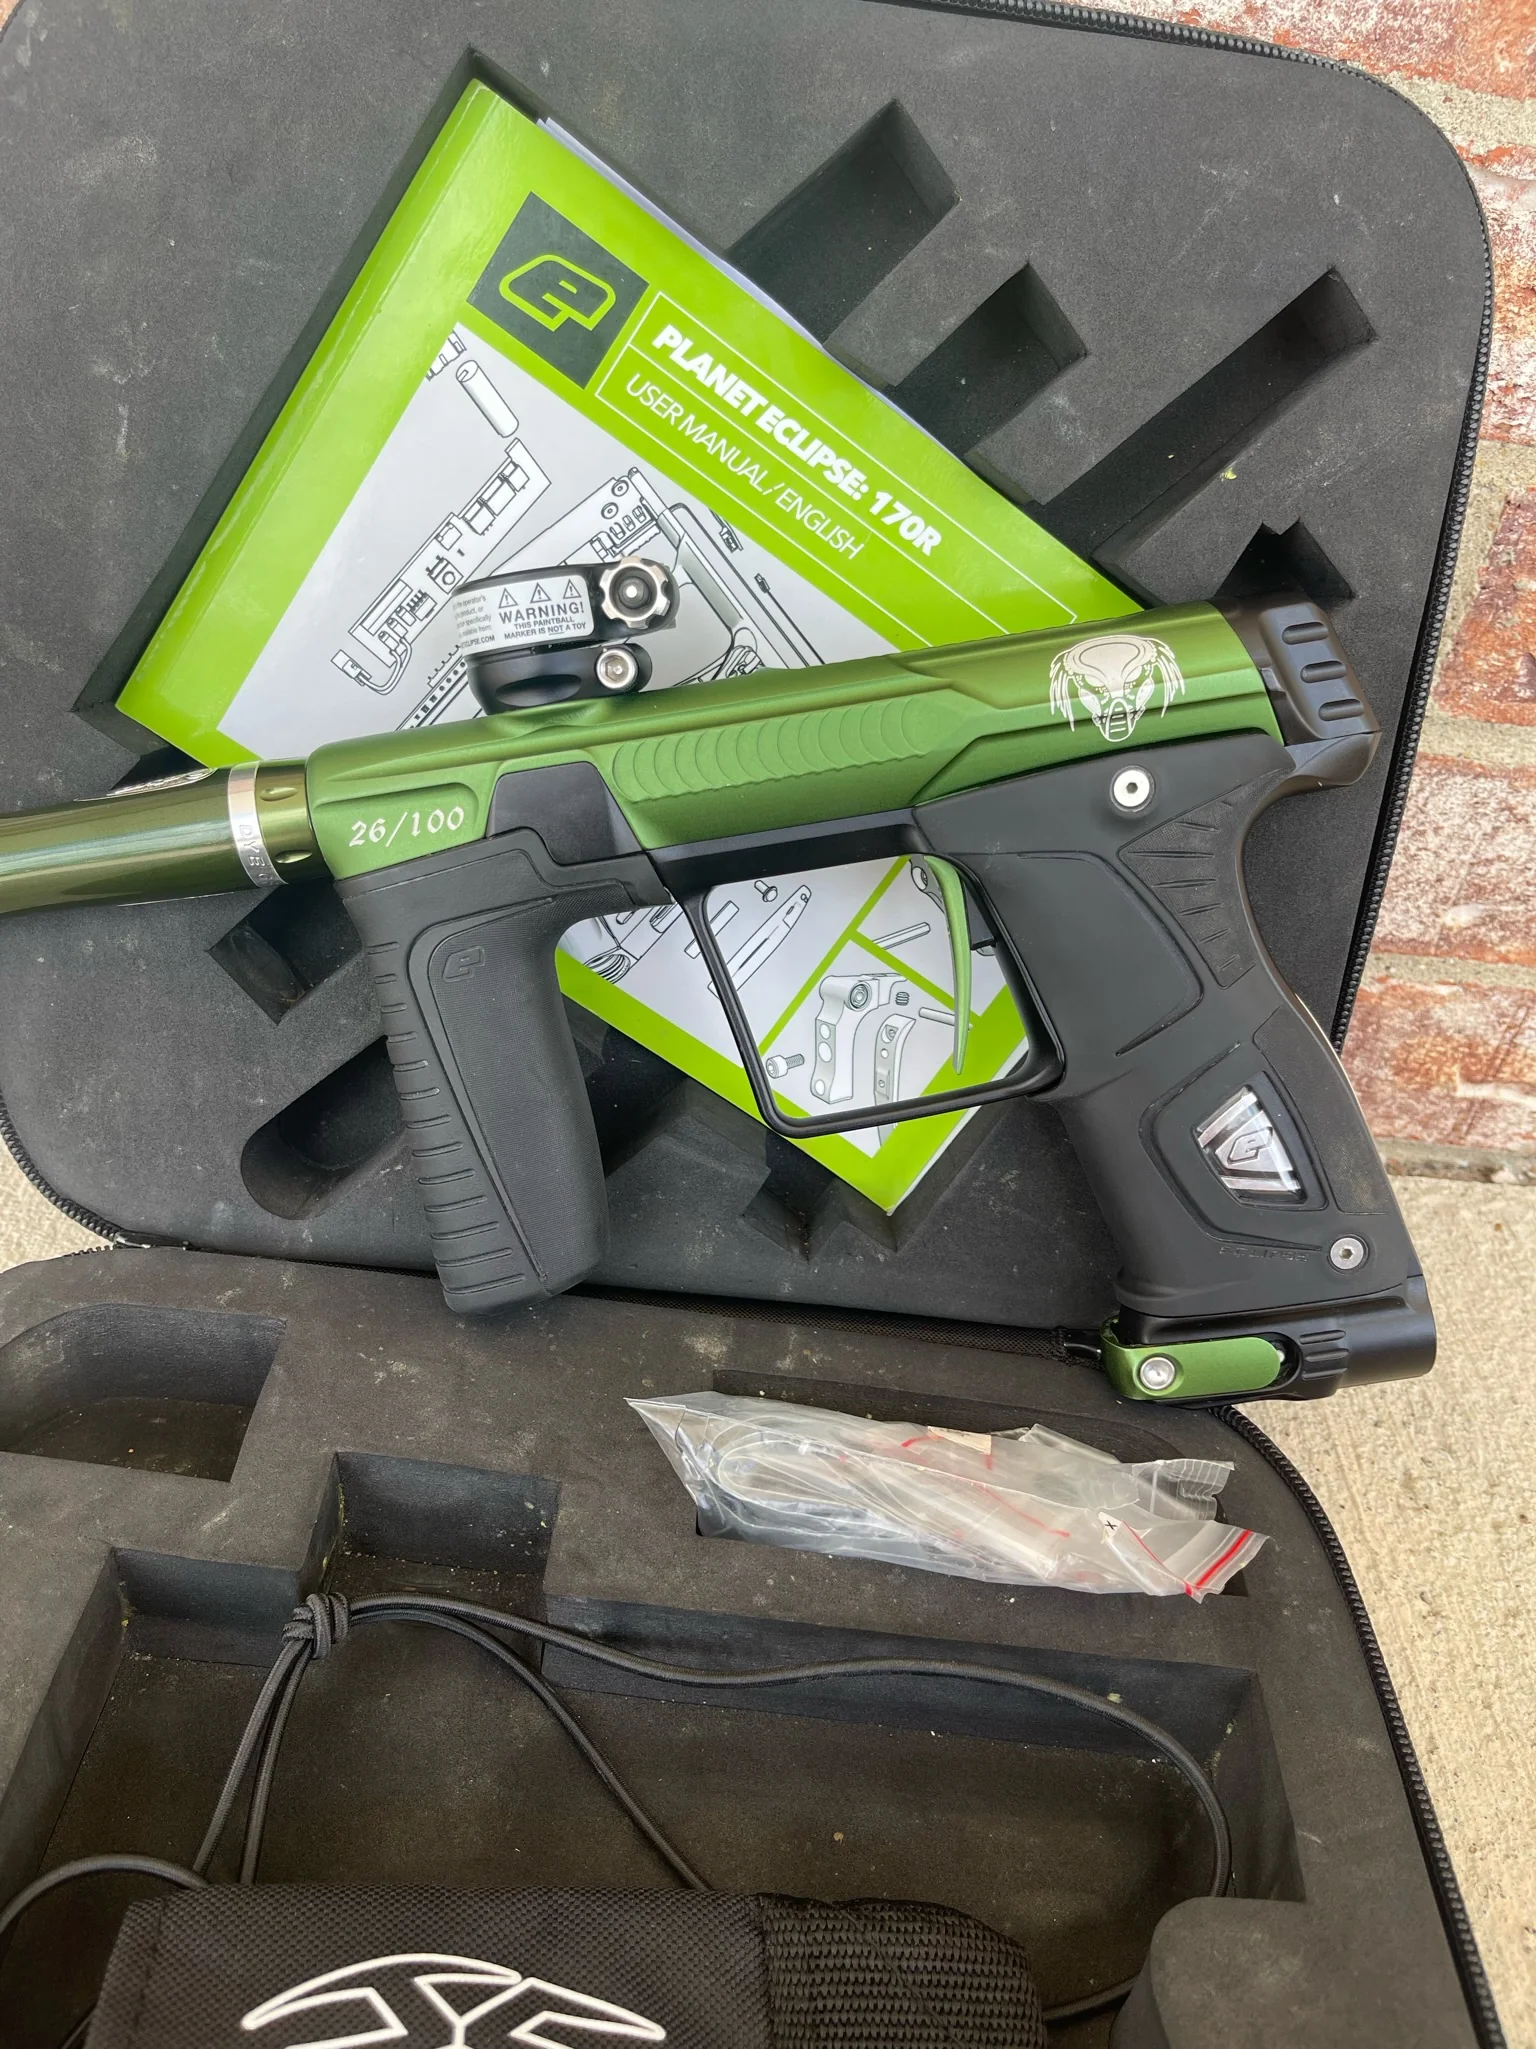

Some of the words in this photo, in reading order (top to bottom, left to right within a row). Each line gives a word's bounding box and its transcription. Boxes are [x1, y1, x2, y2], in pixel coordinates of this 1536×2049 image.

[626, 373, 684, 426] USER
[652, 324, 769, 417] PLANET
[755, 404, 869, 501] ECLIPSE:
[869, 490, 942, 556] 170R
[499, 602, 585, 624] WARNING!
[514, 621, 532, 630] THIS
[533, 616, 575, 627] PAINTBALL
[504, 629, 537, 640] MARKER
[548, 625, 564, 634] NOT
[573, 622, 587, 630] TOY
[349, 806, 465, 848] 26/100
